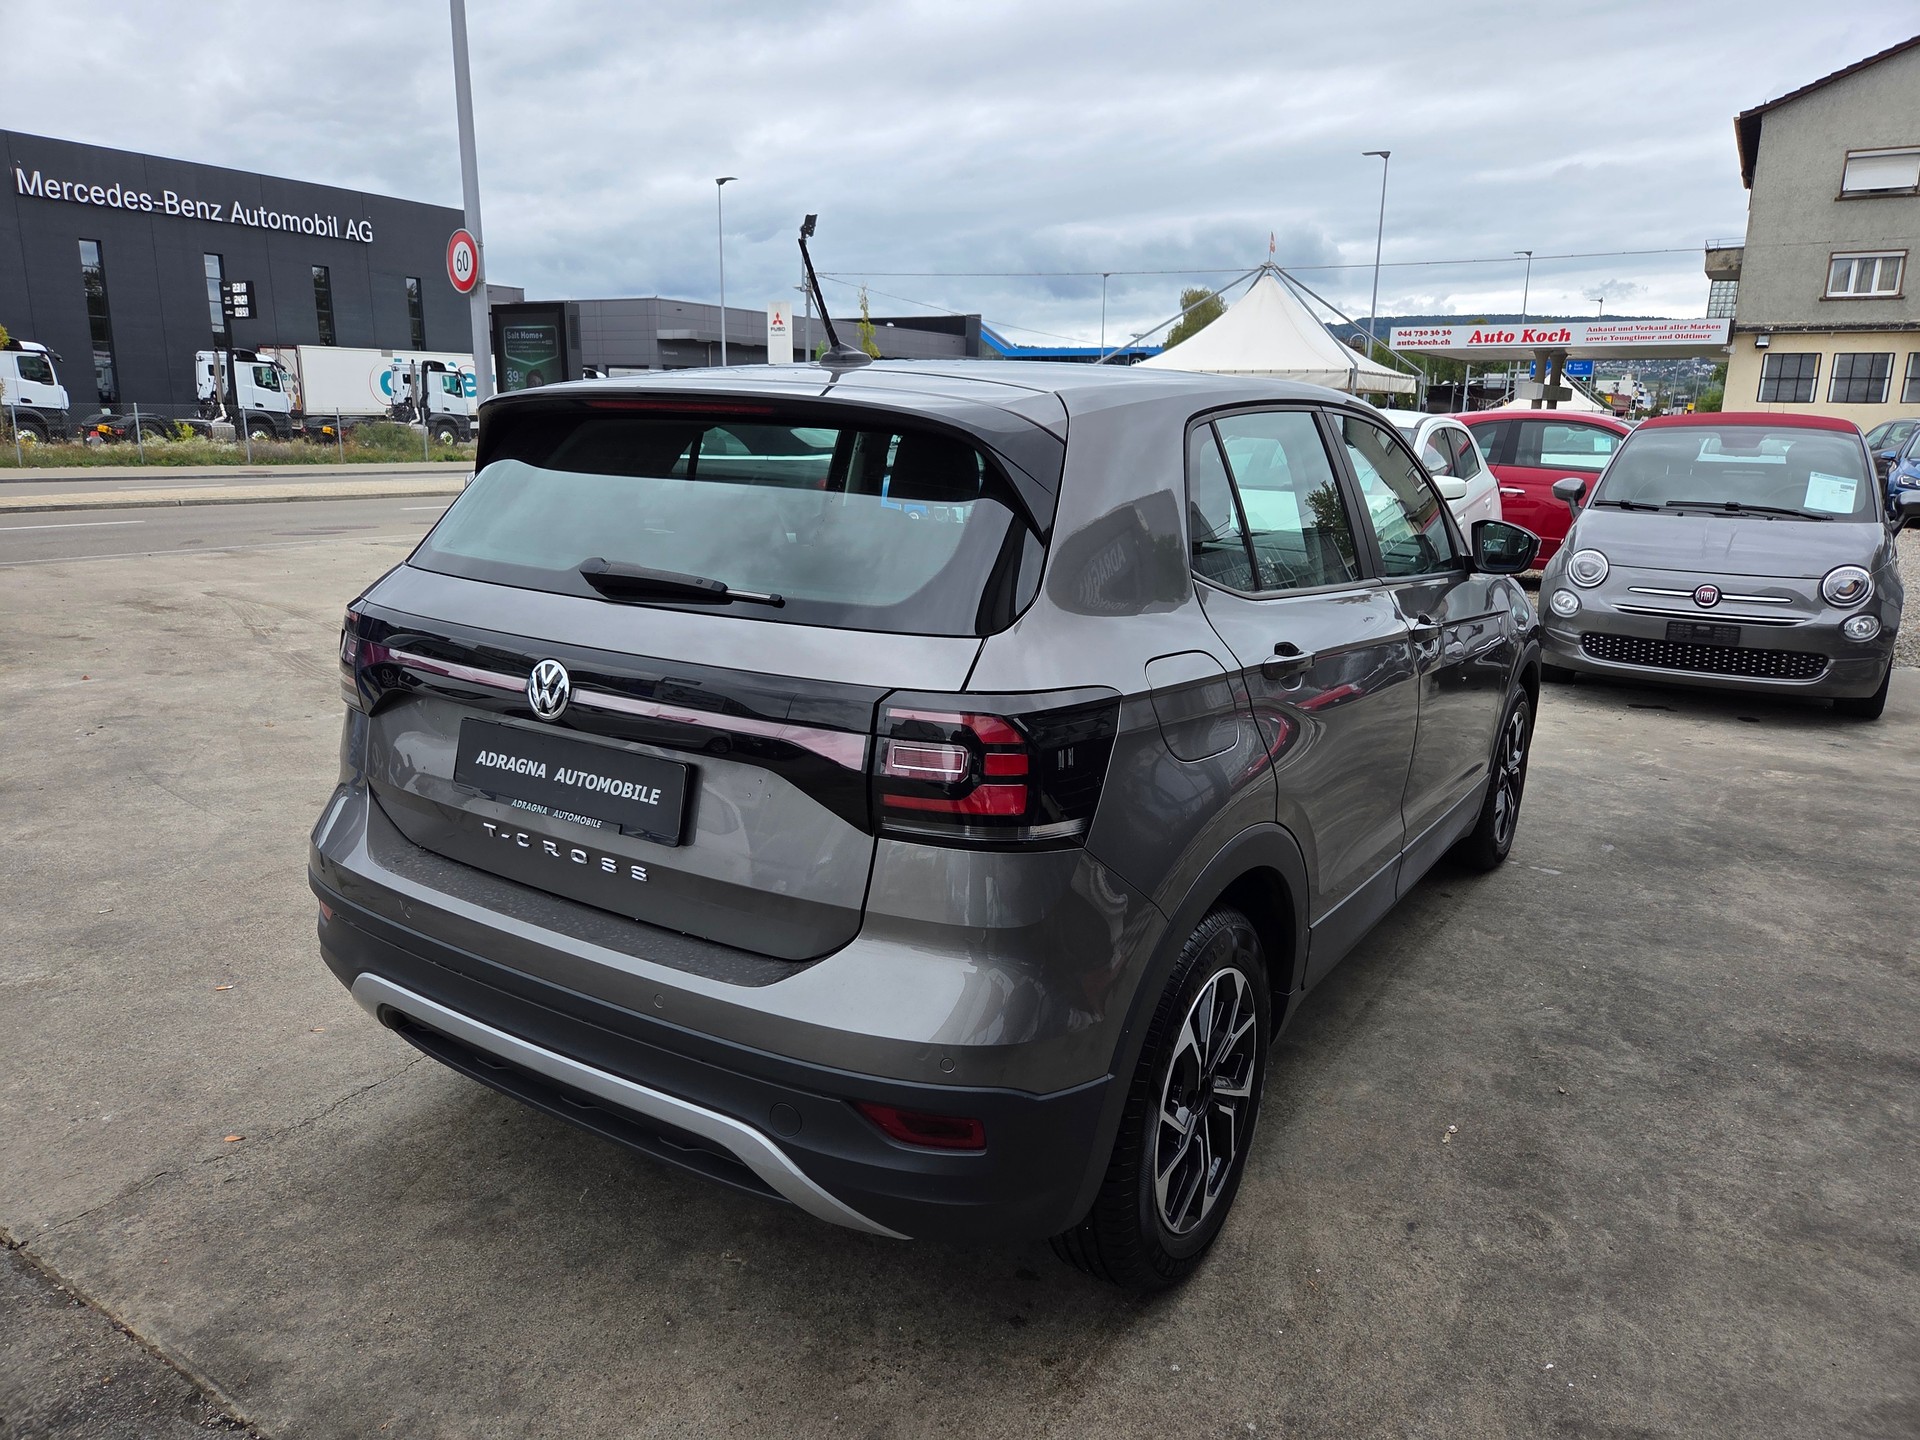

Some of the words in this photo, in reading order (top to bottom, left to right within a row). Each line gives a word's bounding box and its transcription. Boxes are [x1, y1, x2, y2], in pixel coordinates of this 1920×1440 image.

[16, 167, 223, 222] Mercedes-Benz
[230, 200, 339, 238] Automobil
[345, 218, 374, 243] AG
[456, 249, 469, 272] 60
[506, 331, 520, 339] Salt
[520, 331, 544, 339] Home+
[1397, 329, 1414, 337] 044
[1414, 329, 1429, 337] 730
[1441, 328, 1452, 336] 36
[1468, 329, 1515, 344] Auto
[1520, 327, 1572, 343] Koch
[1635, 324, 1668, 332] Verkauf
[1396, 338, 1451, 347] auto-koch.ch
[506, 370, 519, 383] 39
[1700, 591, 1715, 601] FIAT
[475, 750, 547, 778] ADRAGNA
[553, 767, 662, 805] AUTOMOBILE
[511, 798, 548, 815] ADRAGNA
[553, 809, 602, 829] AUTOMOBILE
[483, 822, 649, 882] T-CROSS
